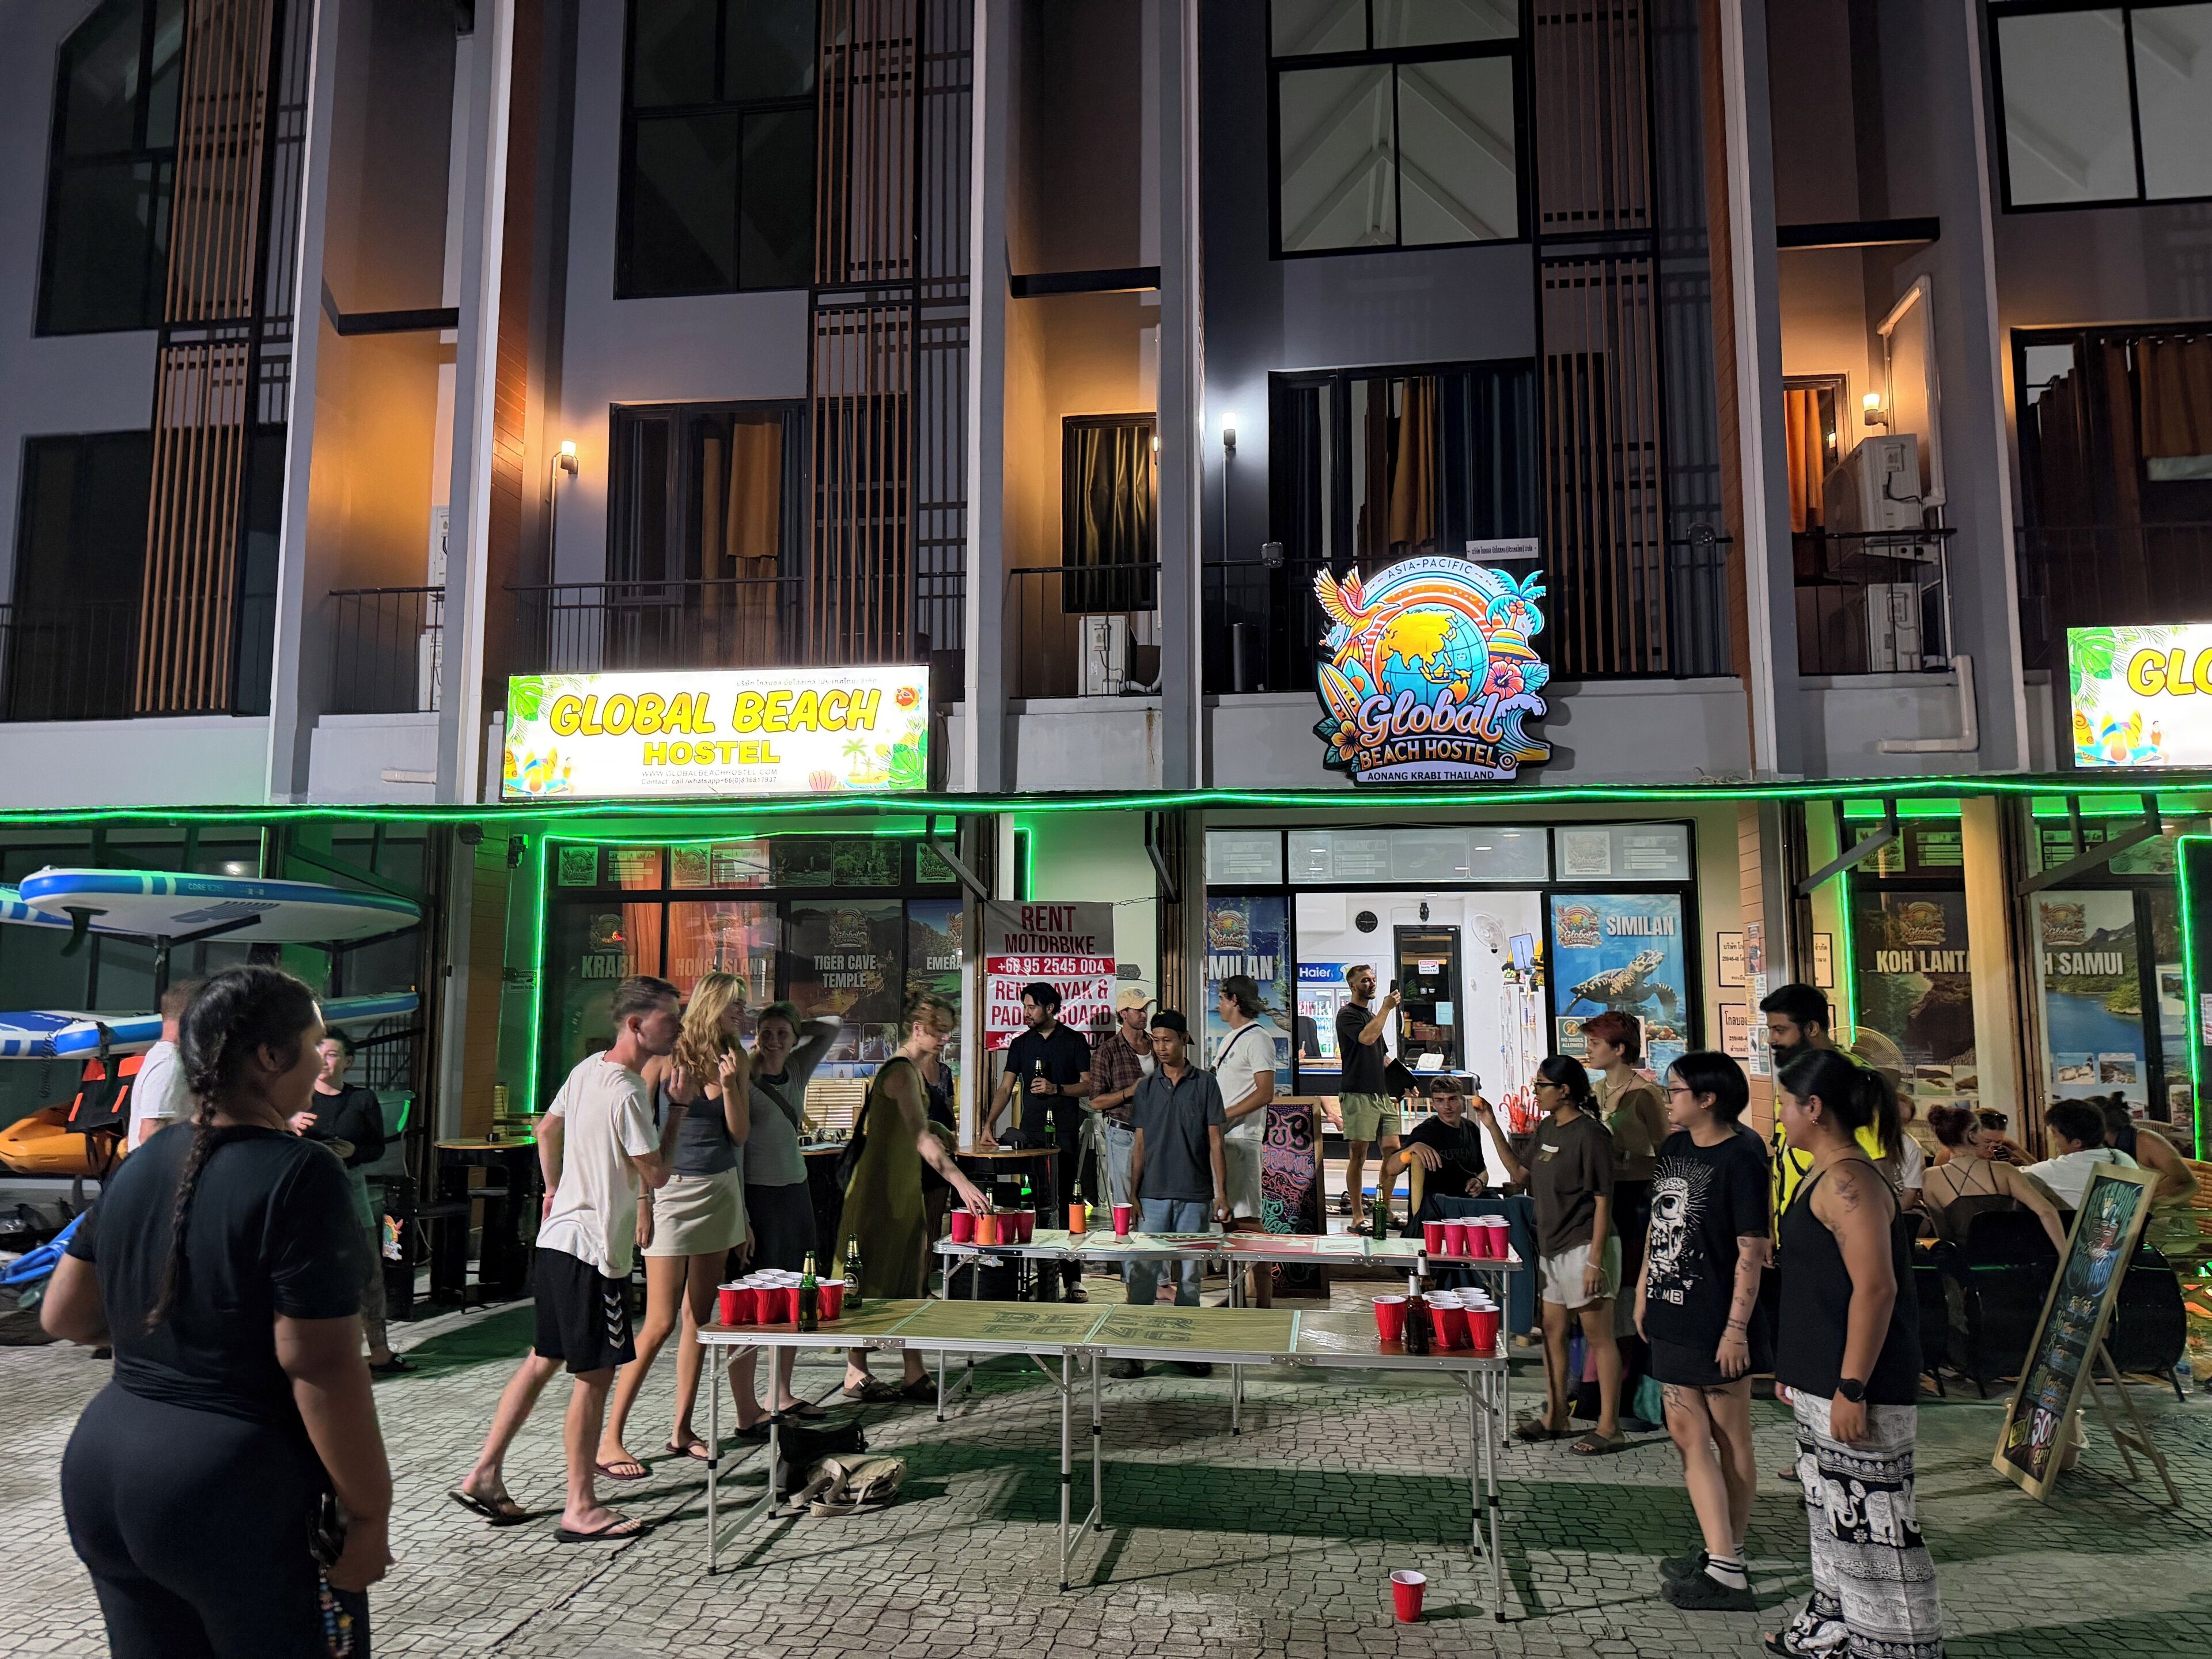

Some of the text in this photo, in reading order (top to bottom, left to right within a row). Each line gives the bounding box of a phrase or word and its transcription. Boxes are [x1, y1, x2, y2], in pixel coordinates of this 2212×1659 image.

[1387, 559, 1474, 579] ASIA-PACIFIC
[550, 688, 882, 736] GLOBAL BEACH
[1357, 688, 1503, 748] Global
[643, 740, 781, 766] HOSTEL
[1359, 740, 1497, 771] BEACH HOSTEL
[1367, 771, 1494, 781] AONANG KRABI THAILAND
[1021, 906, 1076, 932] RENT
[1606, 916, 1674, 936] SIMILAN
[1005, 933, 1096, 955] MOTORBIKE
[582, 955, 635, 978] KRABI
[675, 958, 714, 977] HONG
[814, 955, 877, 971] TIGER CAVE
[1044, 958, 1076, 974] 2545
[1080, 959, 1105, 974] 004
[1876, 950, 1914, 973] KOH
[2058, 952, 2123, 975] SAMUI
[823, 973, 866, 988] TEMPLE
[1298, 967, 1331, 978] Haier
[995, 979, 1108, 1000] REN AYAK &
[987, 1311, 1195, 1330] BEER
[980, 1325, 1192, 1342] PONG
